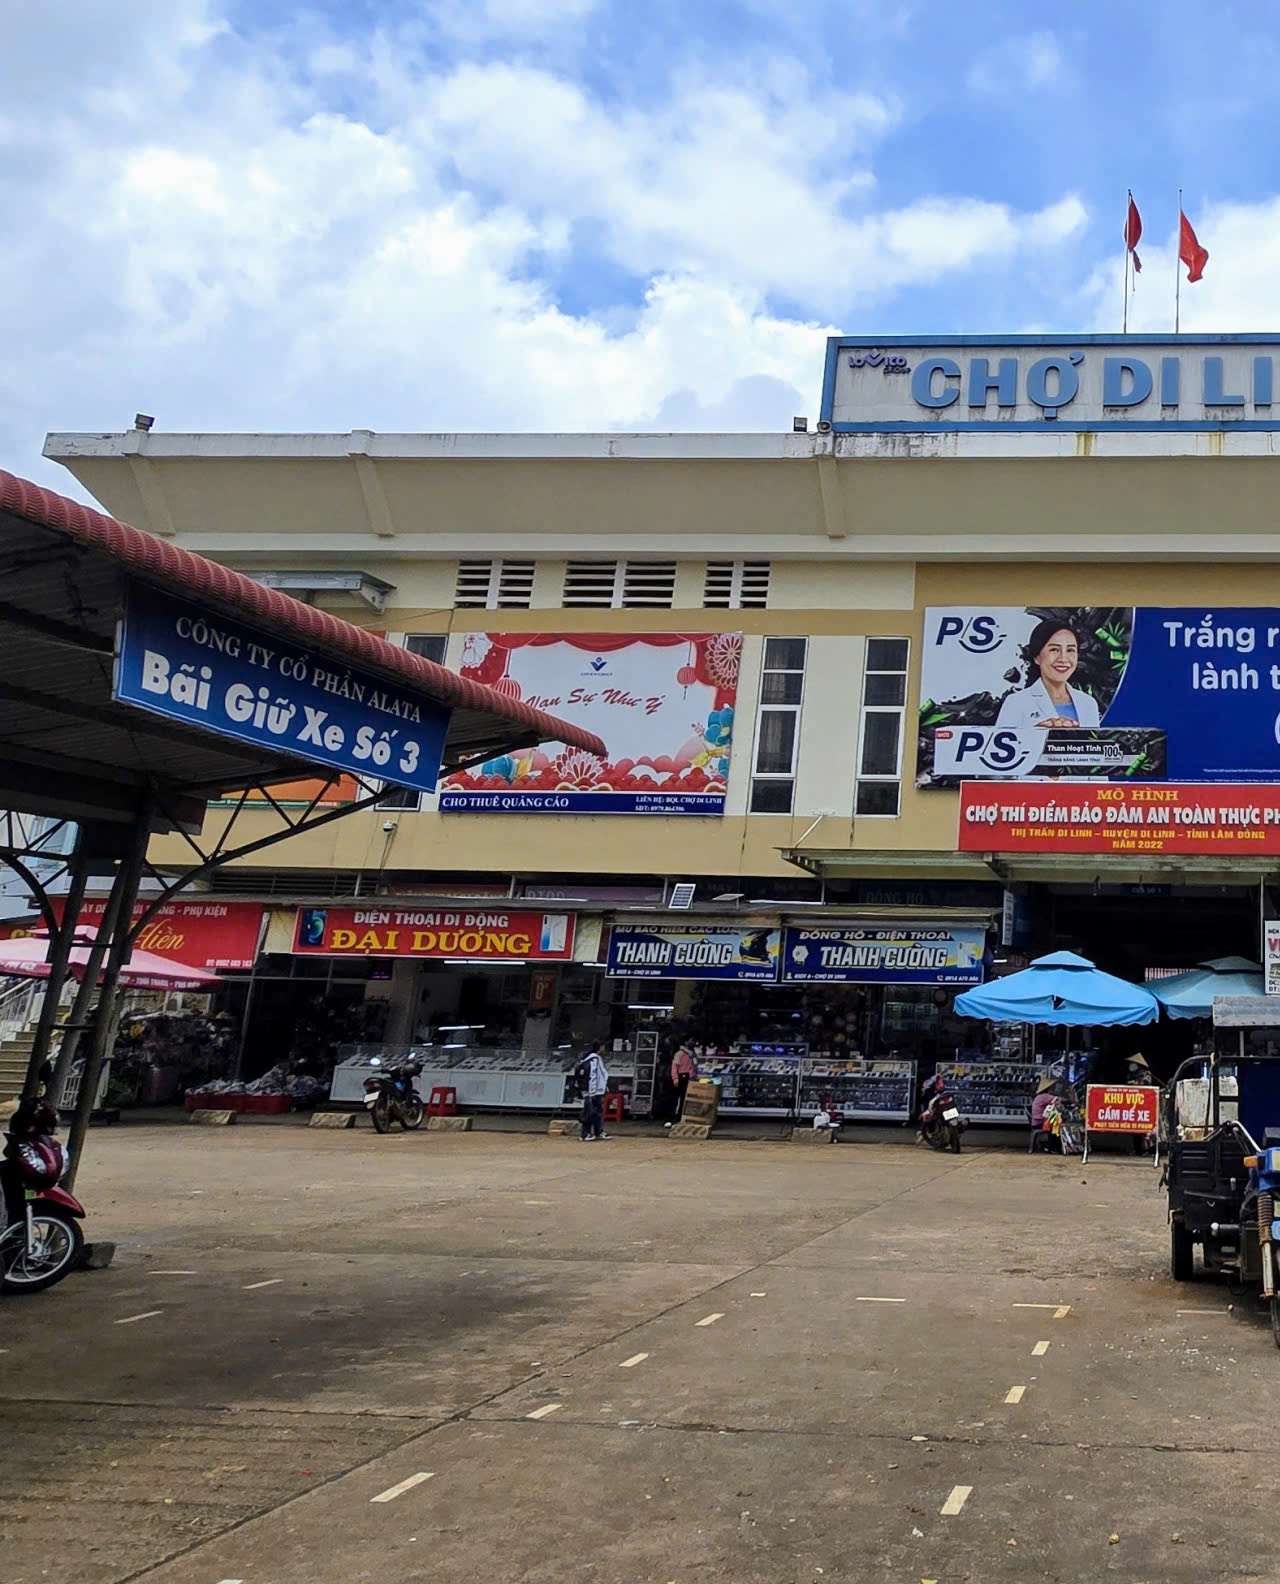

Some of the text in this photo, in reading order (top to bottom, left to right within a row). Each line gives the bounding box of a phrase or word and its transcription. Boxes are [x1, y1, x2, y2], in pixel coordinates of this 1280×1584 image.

[910, 353, 1084, 418] CHỢ
[1103, 355, 1180, 409] DI
[1163, 614, 1256, 653] Trắng
[175, 616, 422, 724] CÔNG TY CỔ PHẦN ALATA
[1191, 662, 1259, 690] lành
[141, 649, 420, 774] Bãi Giữ Xe Số 3
[567, 688, 599, 707] Sự
[602, 688, 643, 707] Như
[645, 694, 667, 715] Ý
[1047, 744, 1065, 753] Than
[1066, 744, 1085, 753] Hoạt
[442, 795, 569, 809] CHO THUÊ QUẢNG CÁO
[1096, 788, 1179, 801] MÔ HÌNH
[965, 803, 998, 826] CHỢ
[1000, 802, 1027, 822] THÍ
[1028, 800, 1069, 823] ĐIỂM
[1071, 801, 1103, 824] BẢO
[1105, 801, 1144, 824] ĐẢM
[1146, 806, 1170, 825] AN
[1172, 802, 1215, 825] TOÀN
[1219, 804, 1260, 828] THỰC
[1011, 826, 1265, 839] THỊ TRẤN DI LINH HUYỆN DI LINH TỈNH LÂM ĐỒNG
[1112, 838, 1164, 849] NĂM 2022
[183, 905, 228, 917] PHỤ KIỆN
[353, 911, 510, 930] ĐIỆN THOẠI DI ĐỘNG
[330, 929, 532, 955] ĐẠI DƯƠNG
[799, 928, 951, 942] ĐỒNG HỒ ĐIỆN THOẠI
[616, 938, 733, 967] THANH CƯỜNG
[820, 943, 948, 969] THANH CƯỜNG
[1104, 1092, 1145, 1107] KHU VỰC
[1098, 1104, 1151, 1121] CẤM ĐỂ XE
